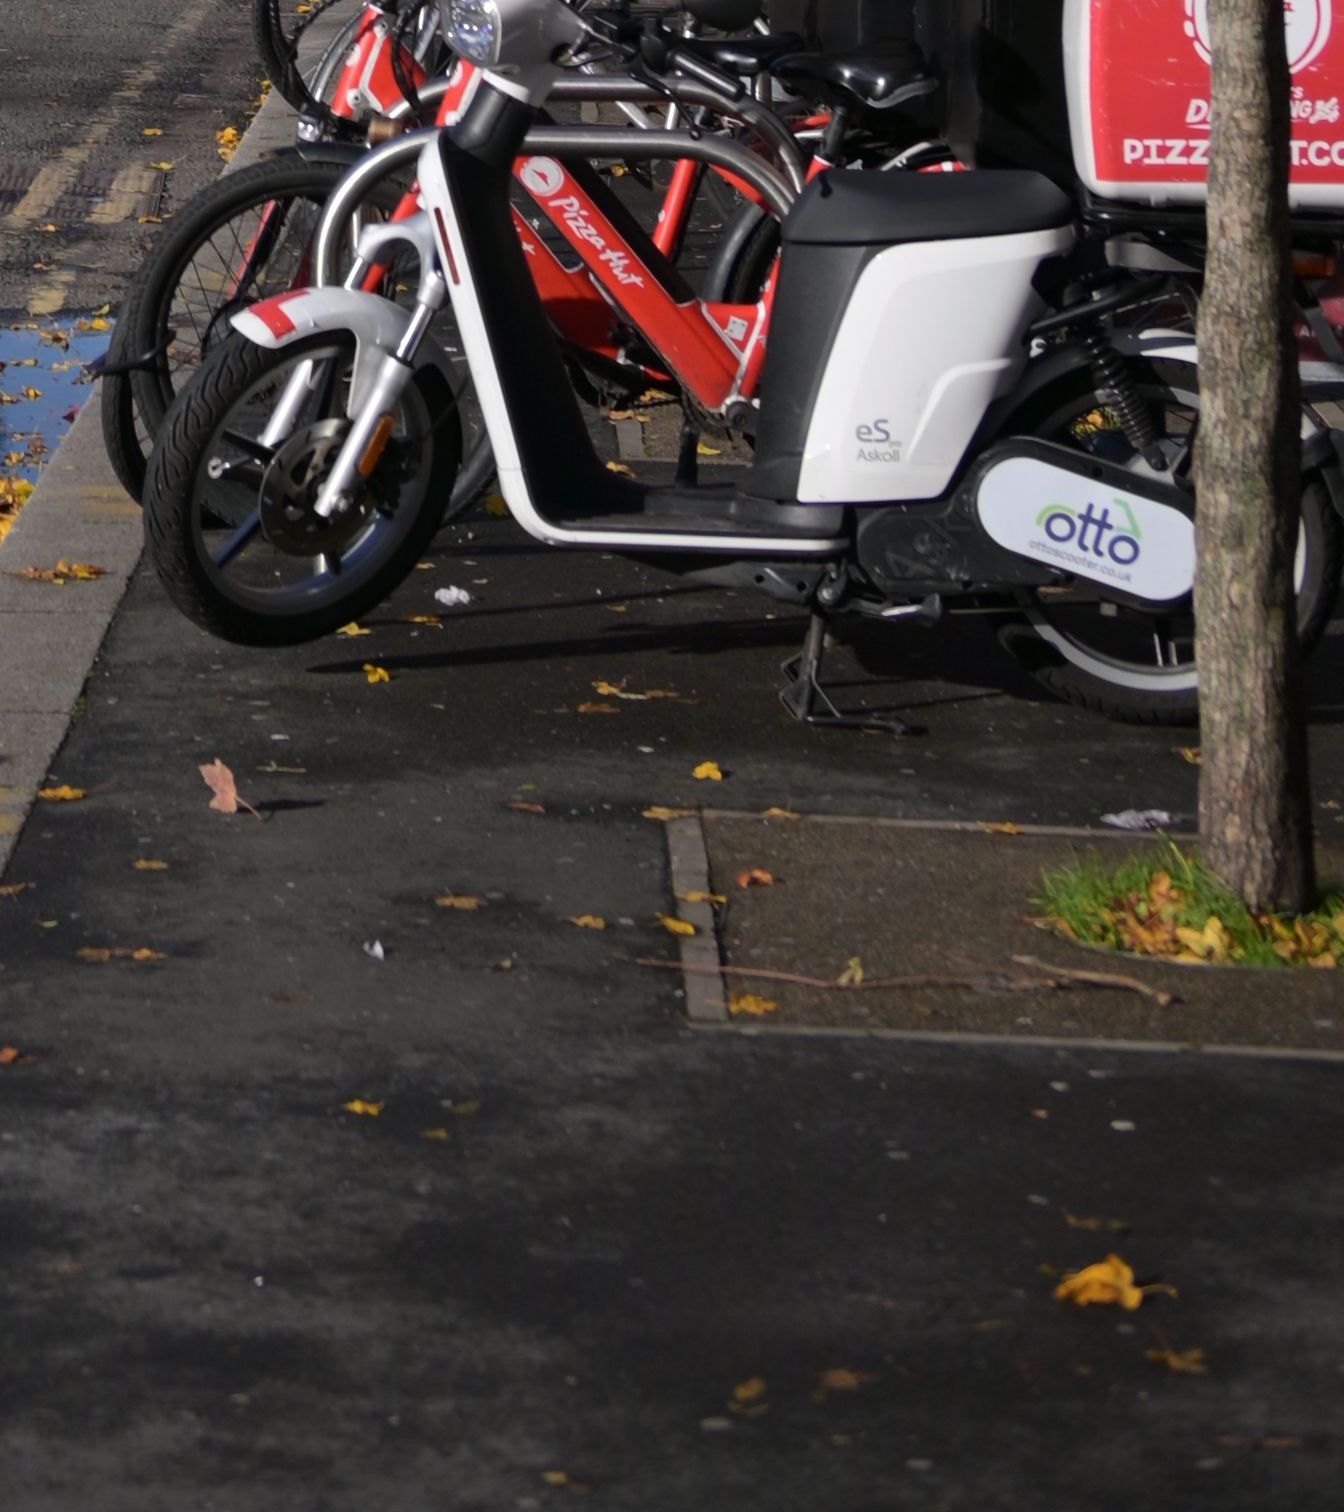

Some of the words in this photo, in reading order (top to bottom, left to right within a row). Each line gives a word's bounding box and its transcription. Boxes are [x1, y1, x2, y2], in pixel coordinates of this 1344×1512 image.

[1122, 138, 1344, 167] PIZZT.CO
[547, 195, 606, 251] Pizza
[599, 247, 645, 289] Hut
[856, 447, 900, 463] Askoll
[1044, 501, 1141, 565] otto
[1027, 537, 1134, 585] ottoscooter.co.uk
